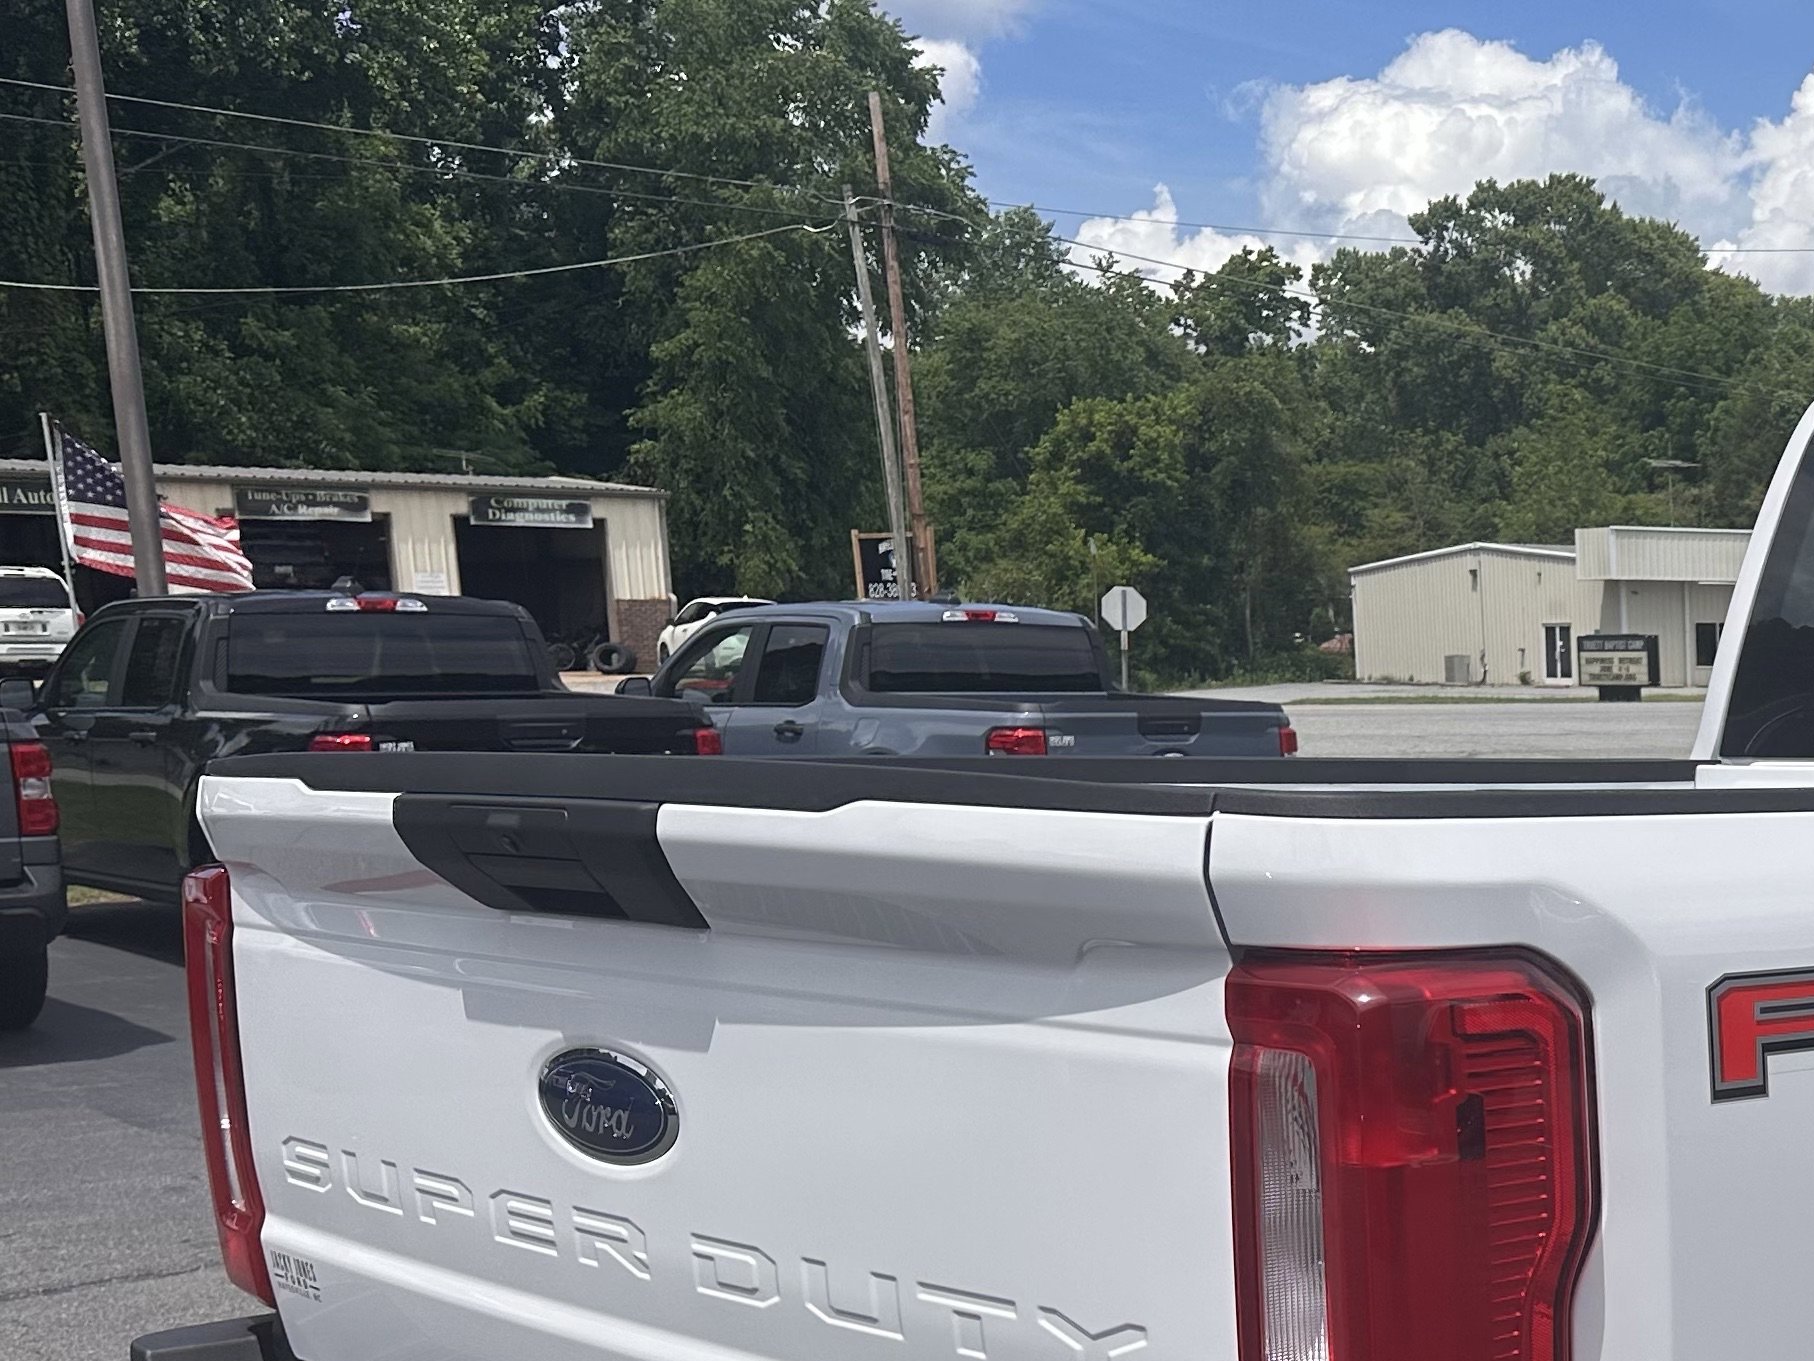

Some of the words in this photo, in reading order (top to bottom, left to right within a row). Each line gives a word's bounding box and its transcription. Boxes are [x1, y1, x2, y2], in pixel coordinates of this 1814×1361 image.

[268, 503, 294, 515] A/C
[297, 504, 340, 517] Repair
[489, 496, 567, 511] Computer
[487, 508, 576, 522] Diagnostics
[561, 1070, 635, 1139] Ford
[280, 1134, 652, 1280] SUPER
